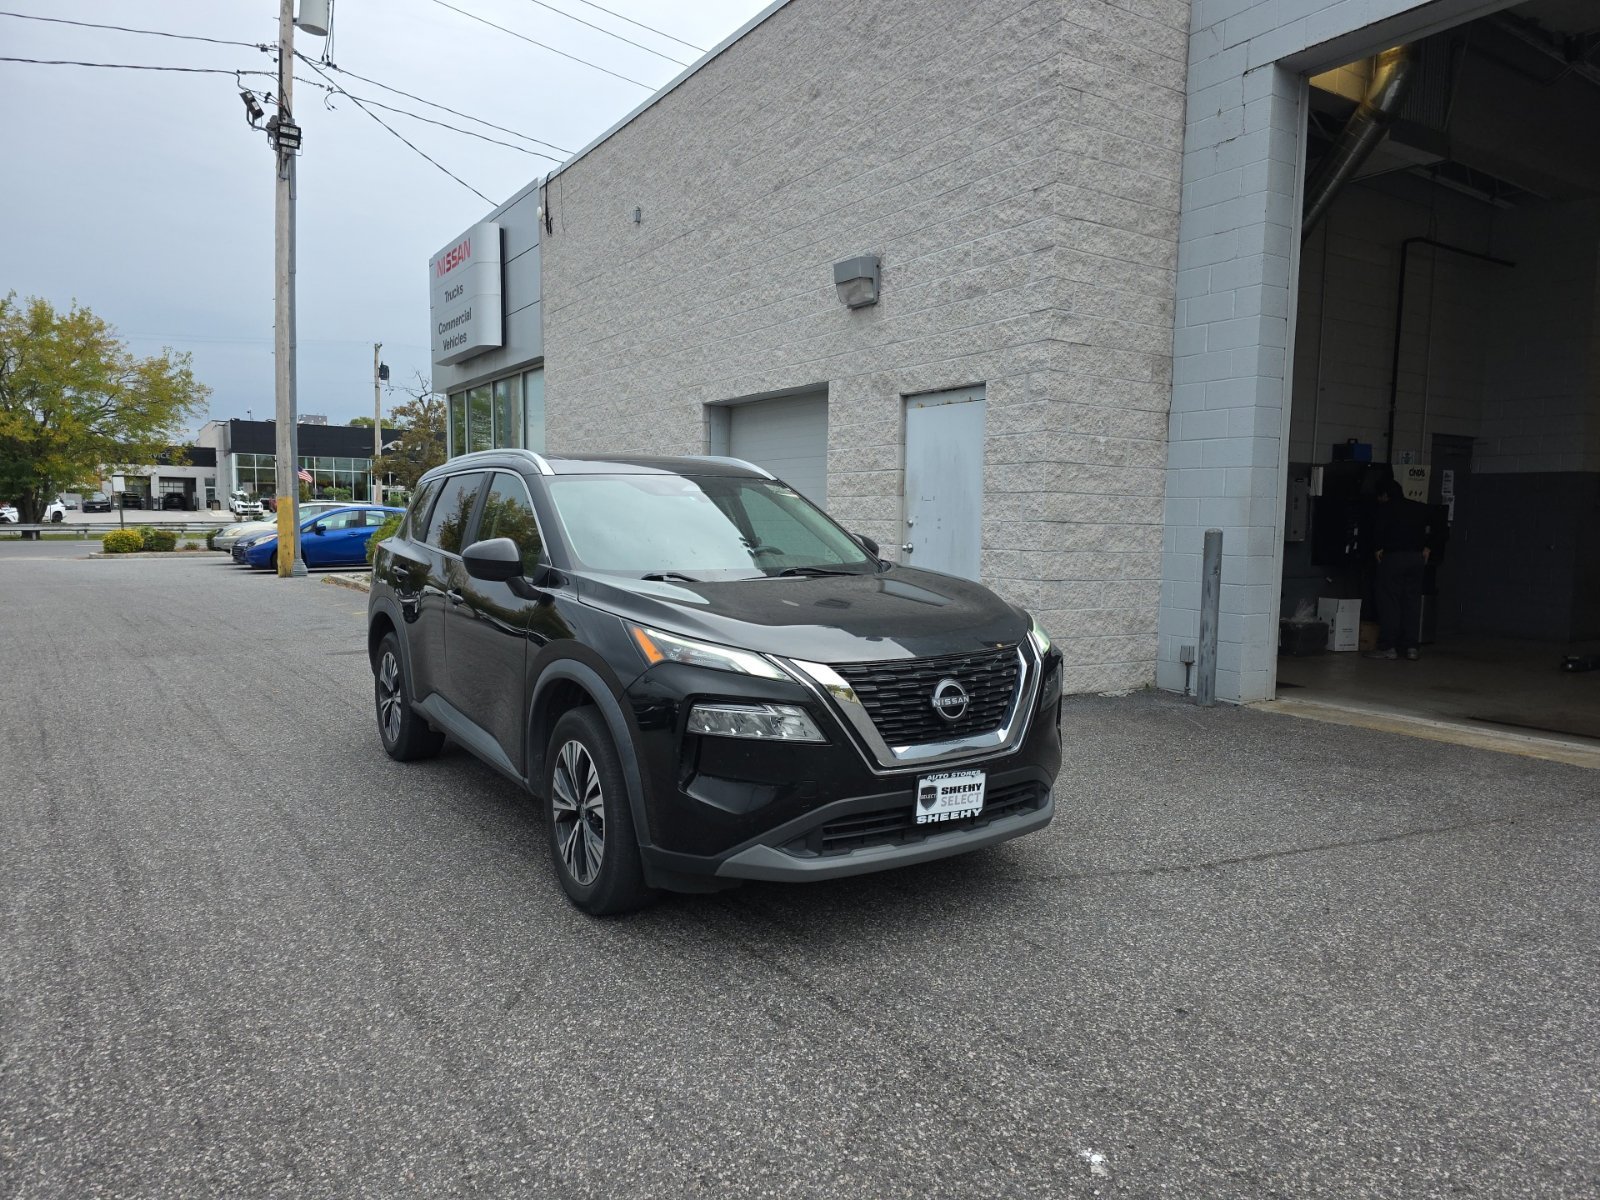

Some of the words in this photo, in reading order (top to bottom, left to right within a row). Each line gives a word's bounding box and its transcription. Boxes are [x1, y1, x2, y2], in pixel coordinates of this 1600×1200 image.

[436, 237, 471, 278] NISSAN
[444, 283, 464, 303] Trucks
[438, 307, 472, 335] Commercial
[442, 331, 467, 351] Vehicles
[933, 695, 970, 707] NISSAN
[926, 773, 949, 781] AUTO
[941, 782, 982, 795] SHEEHY
[940, 792, 982, 807] SELECT
[916, 808, 983, 824] SHEEHY
